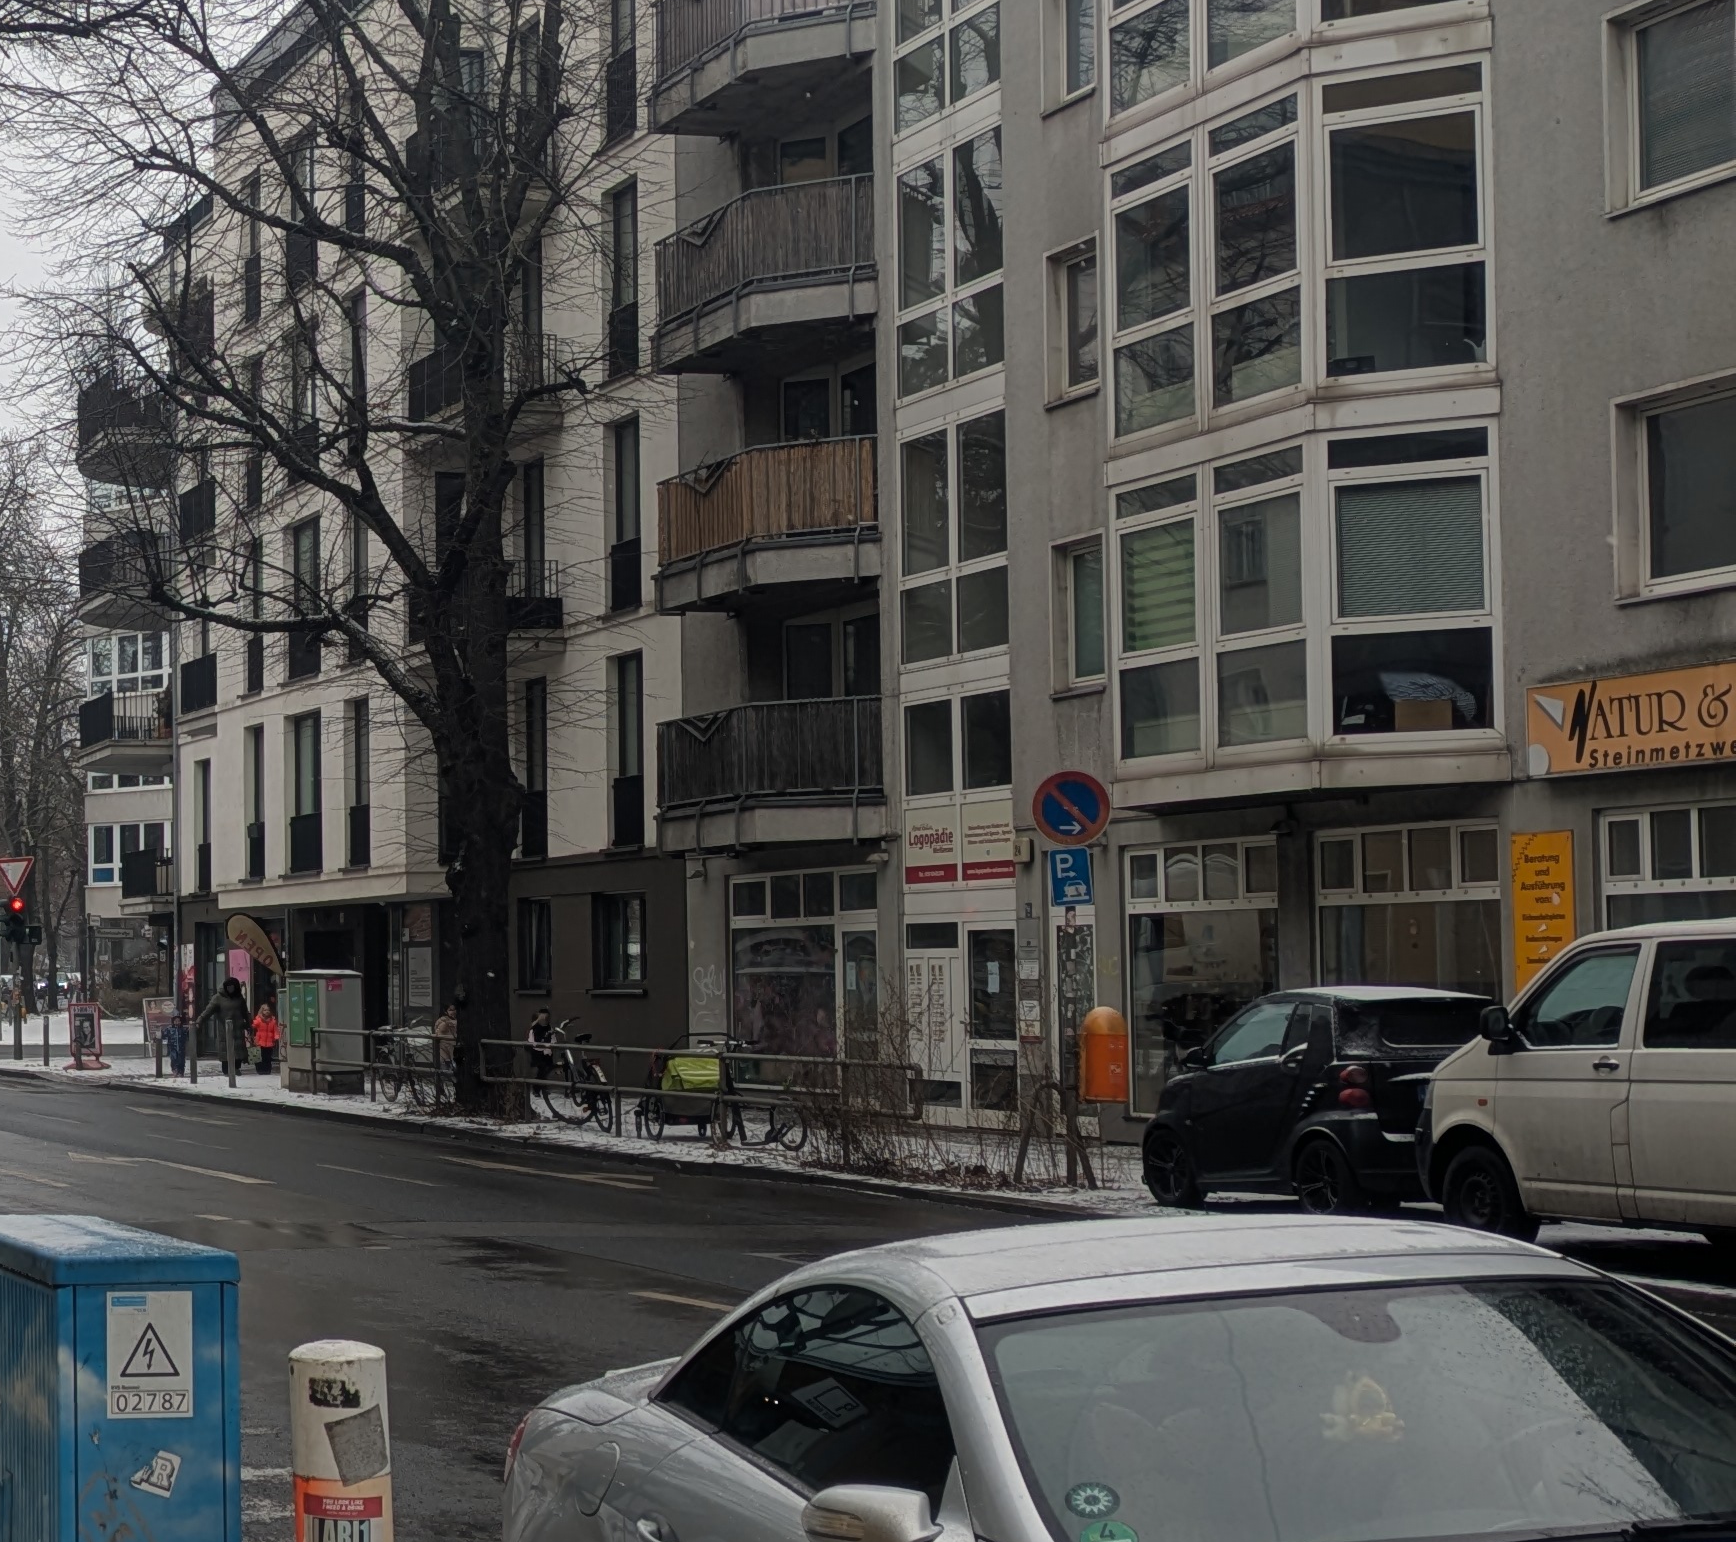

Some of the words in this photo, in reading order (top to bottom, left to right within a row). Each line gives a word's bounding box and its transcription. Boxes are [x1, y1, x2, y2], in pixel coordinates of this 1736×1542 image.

[1569, 680, 1688, 763] NATUR
[1698, 683, 1733, 728] &
[908, 827, 954, 850] Logopädie
[1055, 853, 1074, 879] P
[1524, 854, 1560, 864] Beratung
[1520, 880, 1566, 891] Ausführung
[116, 1392, 187, 1412] 02787
[1100, 1522, 1116, 1540] 4
